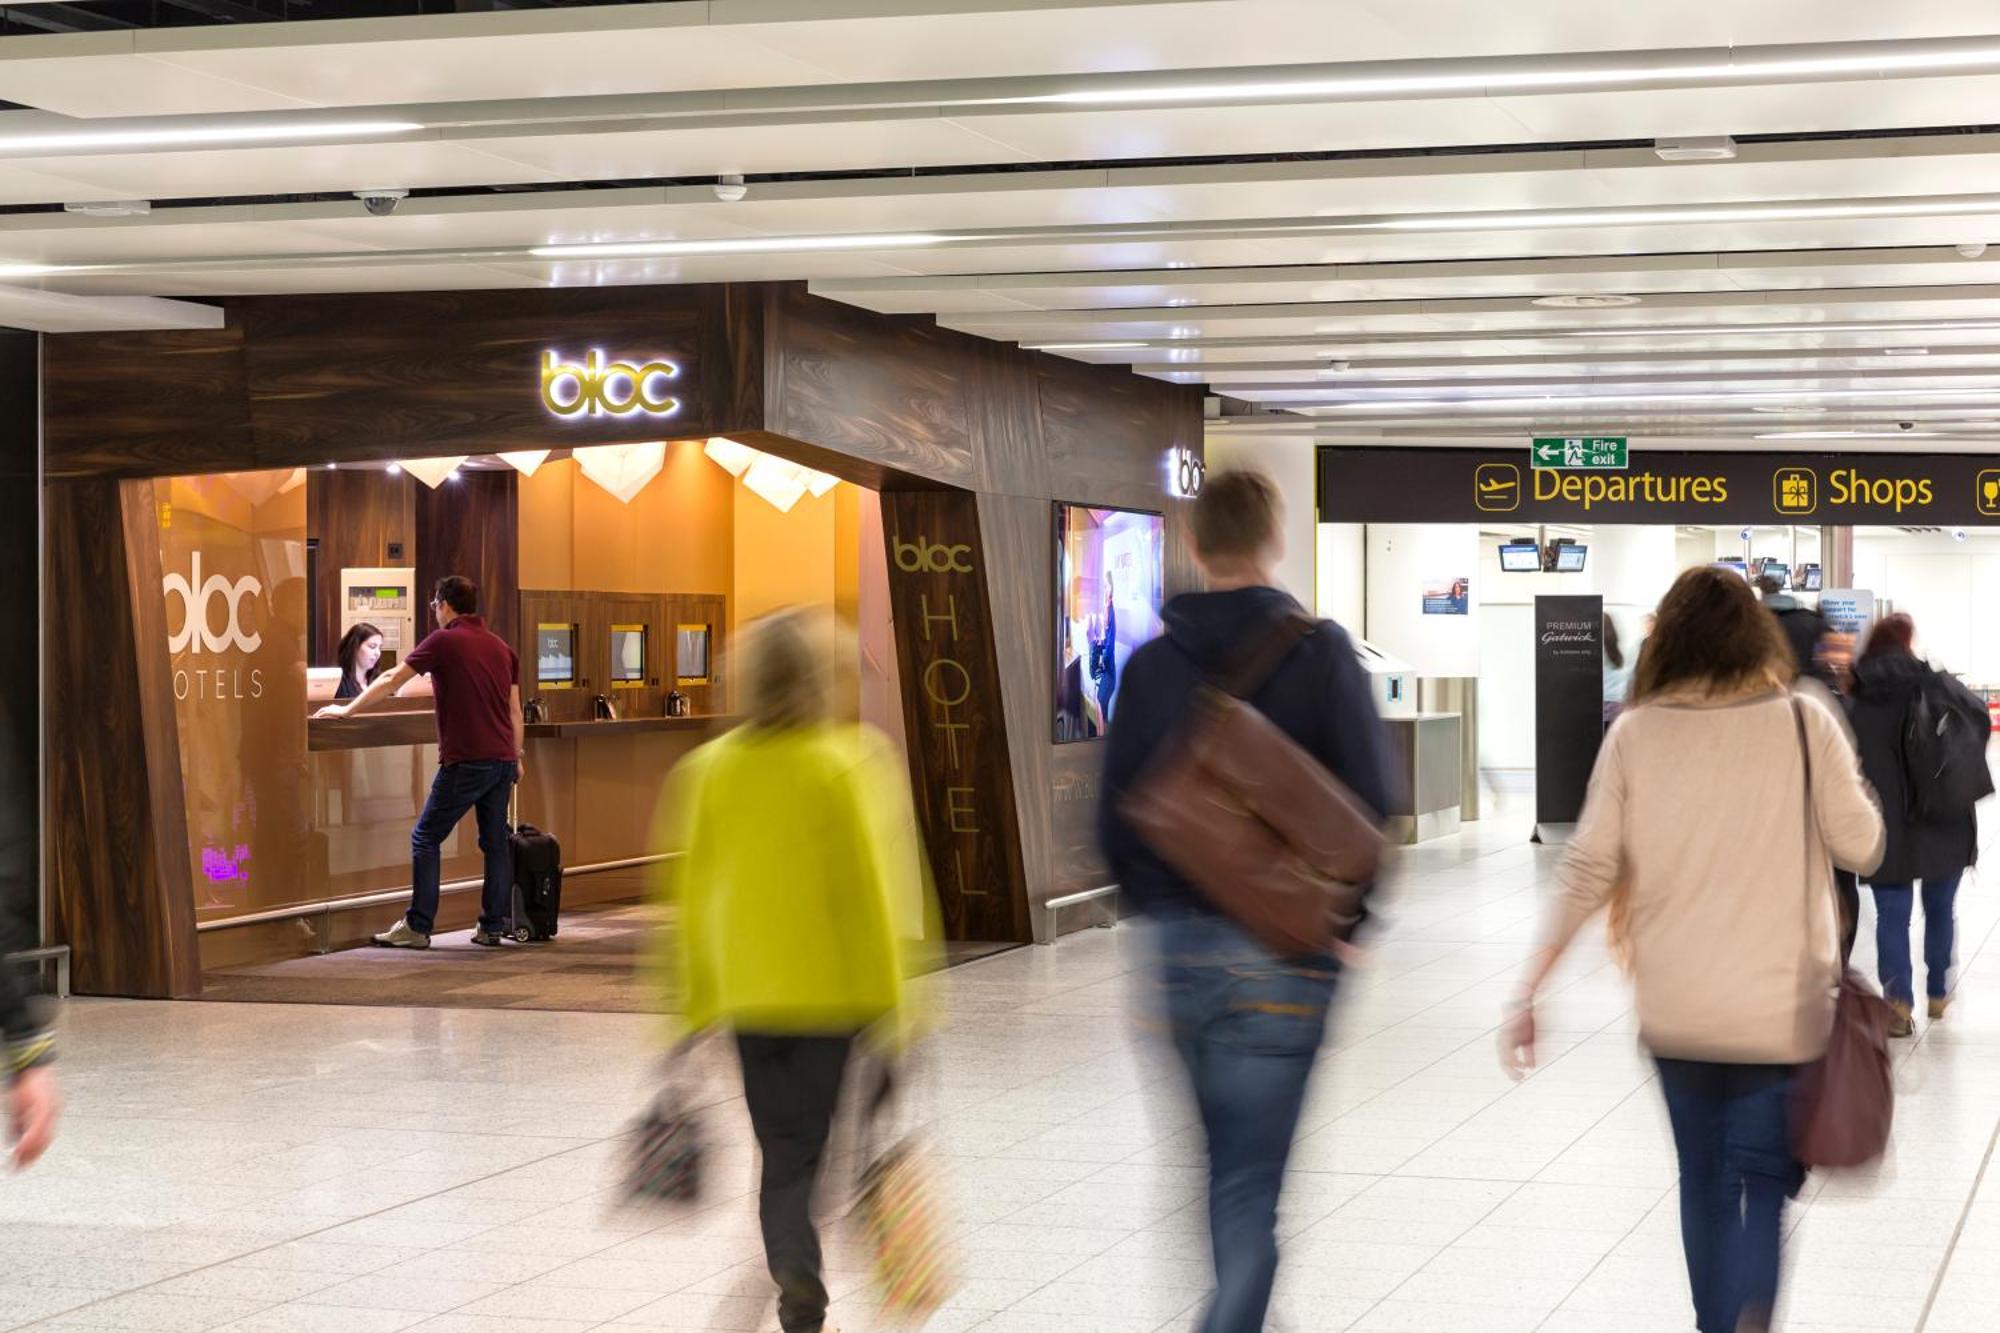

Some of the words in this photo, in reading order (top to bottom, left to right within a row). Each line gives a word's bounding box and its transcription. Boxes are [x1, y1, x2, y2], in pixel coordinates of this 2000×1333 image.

[541, 350, 678, 416] bloc
[1592, 440, 1618, 451] Fire
[1592, 454, 1616, 465] exit
[1534, 469, 1728, 510] Departures
[1829, 469, 1933, 512] Shops
[893, 536, 974, 573] bloc
[1541, 631, 1597, 645] Gatwick
[1546, 621, 1592, 631] PREMIUM
[173, 669, 264, 700] OTELS
[921, 594, 988, 895] HOTEL
